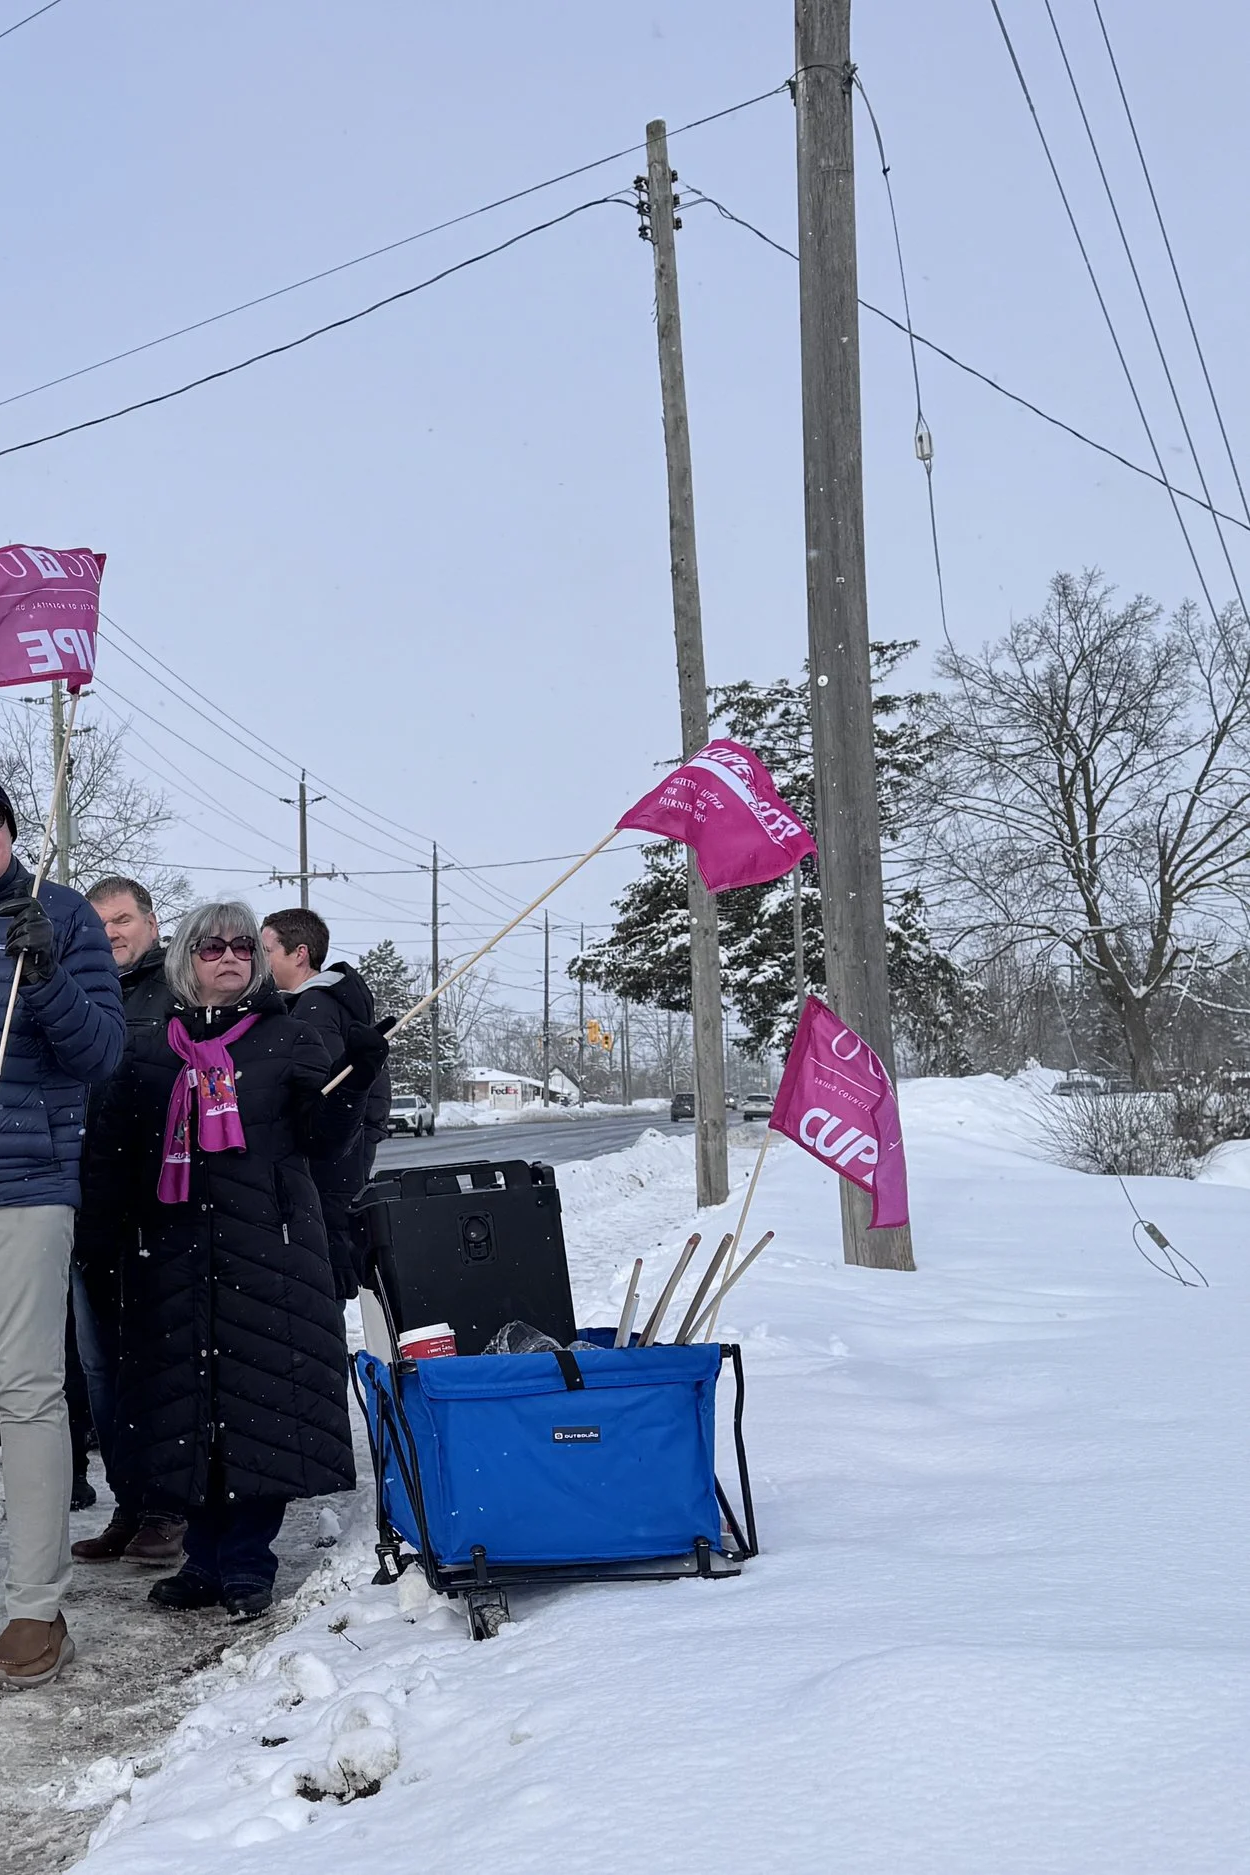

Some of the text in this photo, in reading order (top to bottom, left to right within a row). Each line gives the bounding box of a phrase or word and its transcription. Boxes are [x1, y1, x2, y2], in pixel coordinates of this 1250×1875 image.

[491, 1086, 519, 1095] FedEx
[838, 1089, 871, 1112] COUNCIL
[799, 1107, 879, 1185] CUP
